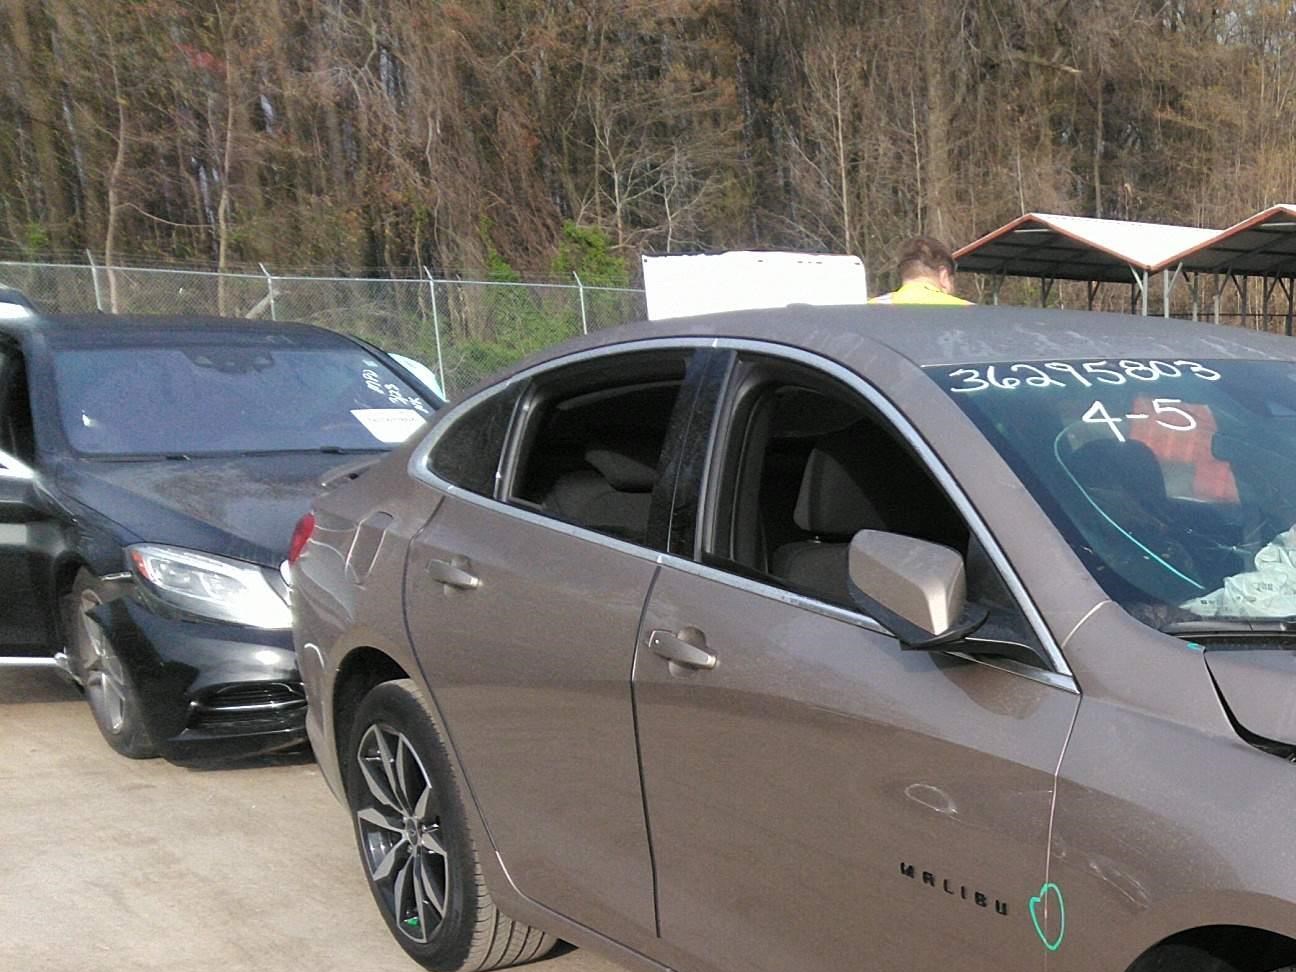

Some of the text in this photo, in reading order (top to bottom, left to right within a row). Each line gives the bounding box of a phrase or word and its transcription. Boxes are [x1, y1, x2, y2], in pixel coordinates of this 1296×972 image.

[948, 359, 1222, 393] 36295803
[1081, 397, 1198, 443] 4-5
[900, 861, 1008, 916] MALIBU
